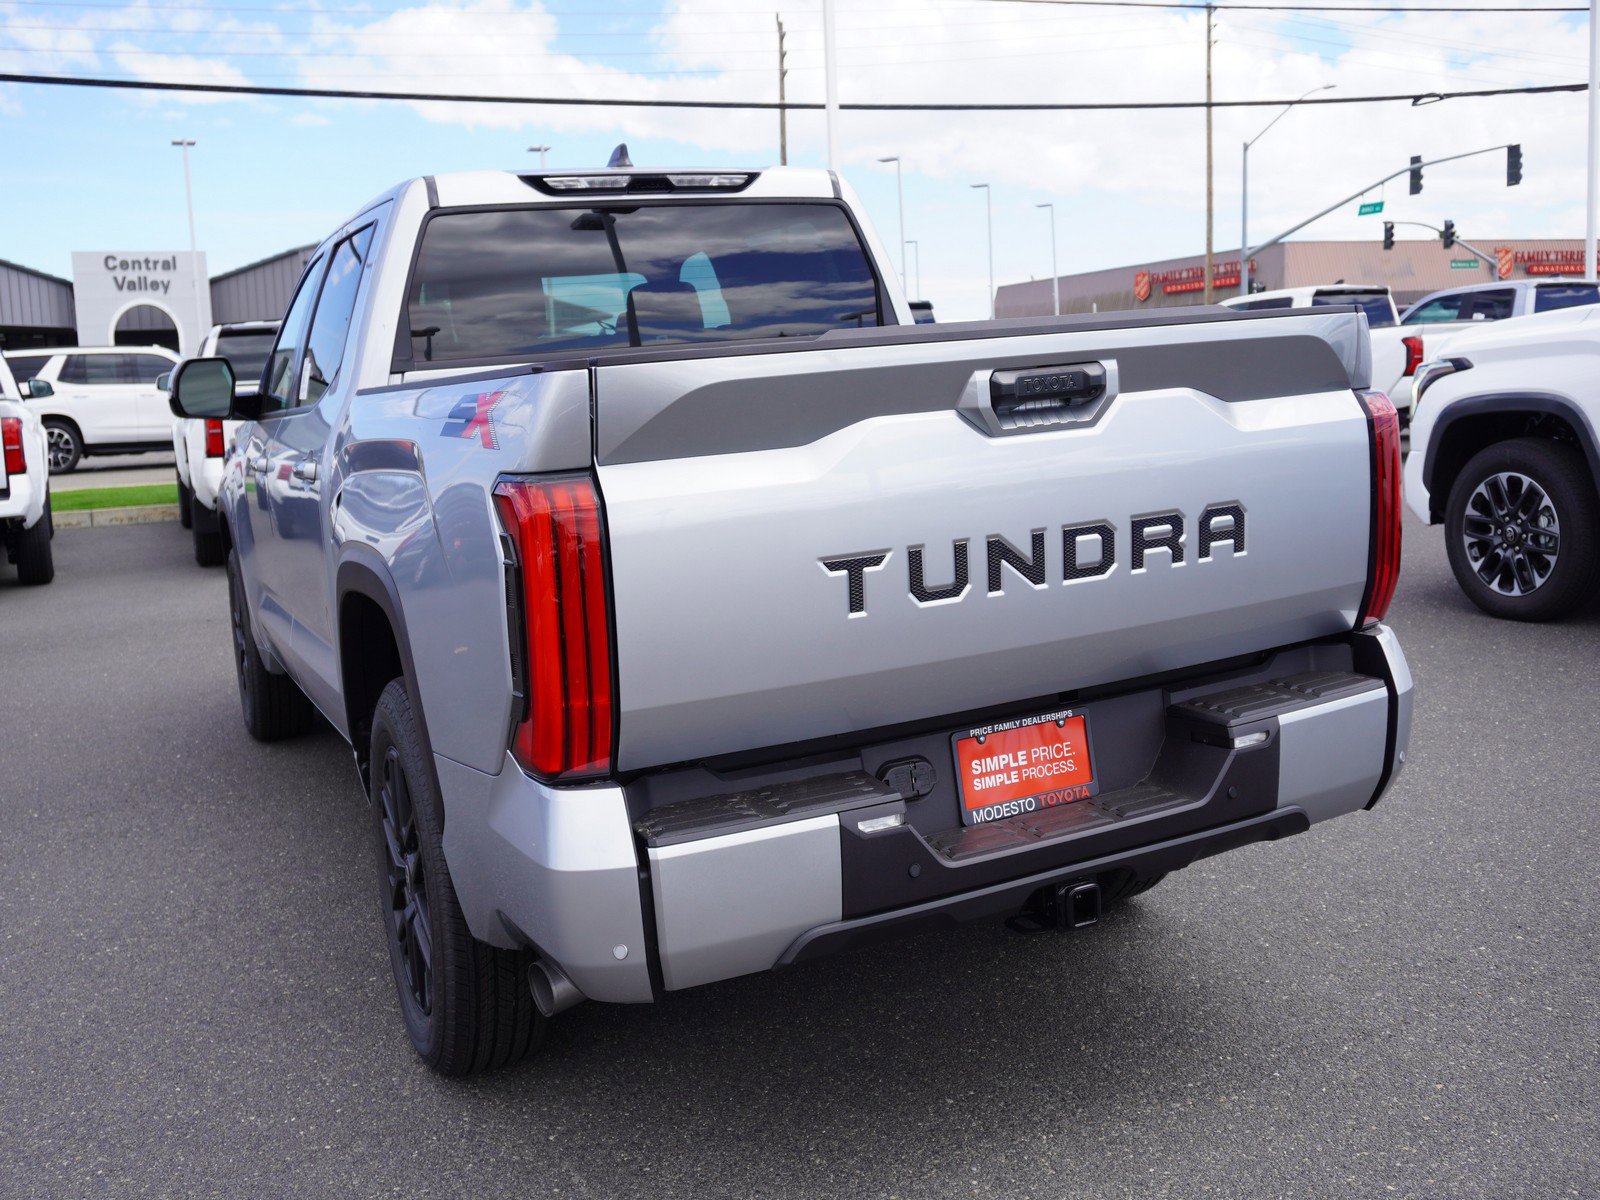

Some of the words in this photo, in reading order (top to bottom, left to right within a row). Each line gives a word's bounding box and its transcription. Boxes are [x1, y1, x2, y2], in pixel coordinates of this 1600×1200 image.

[103, 255, 177, 271] Central
[1514, 250, 1552, 263] FAMILY
[1555, 249, 1586, 262] THRIF
[112, 275, 171, 295] Valley
[1151, 269, 1184, 284] FAMILY
[1023, 374, 1077, 393] TOYOTA
[817, 499, 1248, 619] TUNDRA
[969, 725, 993, 738] PRICE
[994, 719, 1021, 733] FAMILY
[1022, 709, 1073, 727] DEALERSHIPS
[971, 750, 1028, 774] SIMPLE
[1031, 741, 1076, 763] PRICE.
[973, 770, 1020, 791] SIMPLE
[1022, 759, 1078, 781] PROCESS.
[973, 797, 1036, 823] MODESTO
[1038, 785, 1090, 808] TOYOTA
